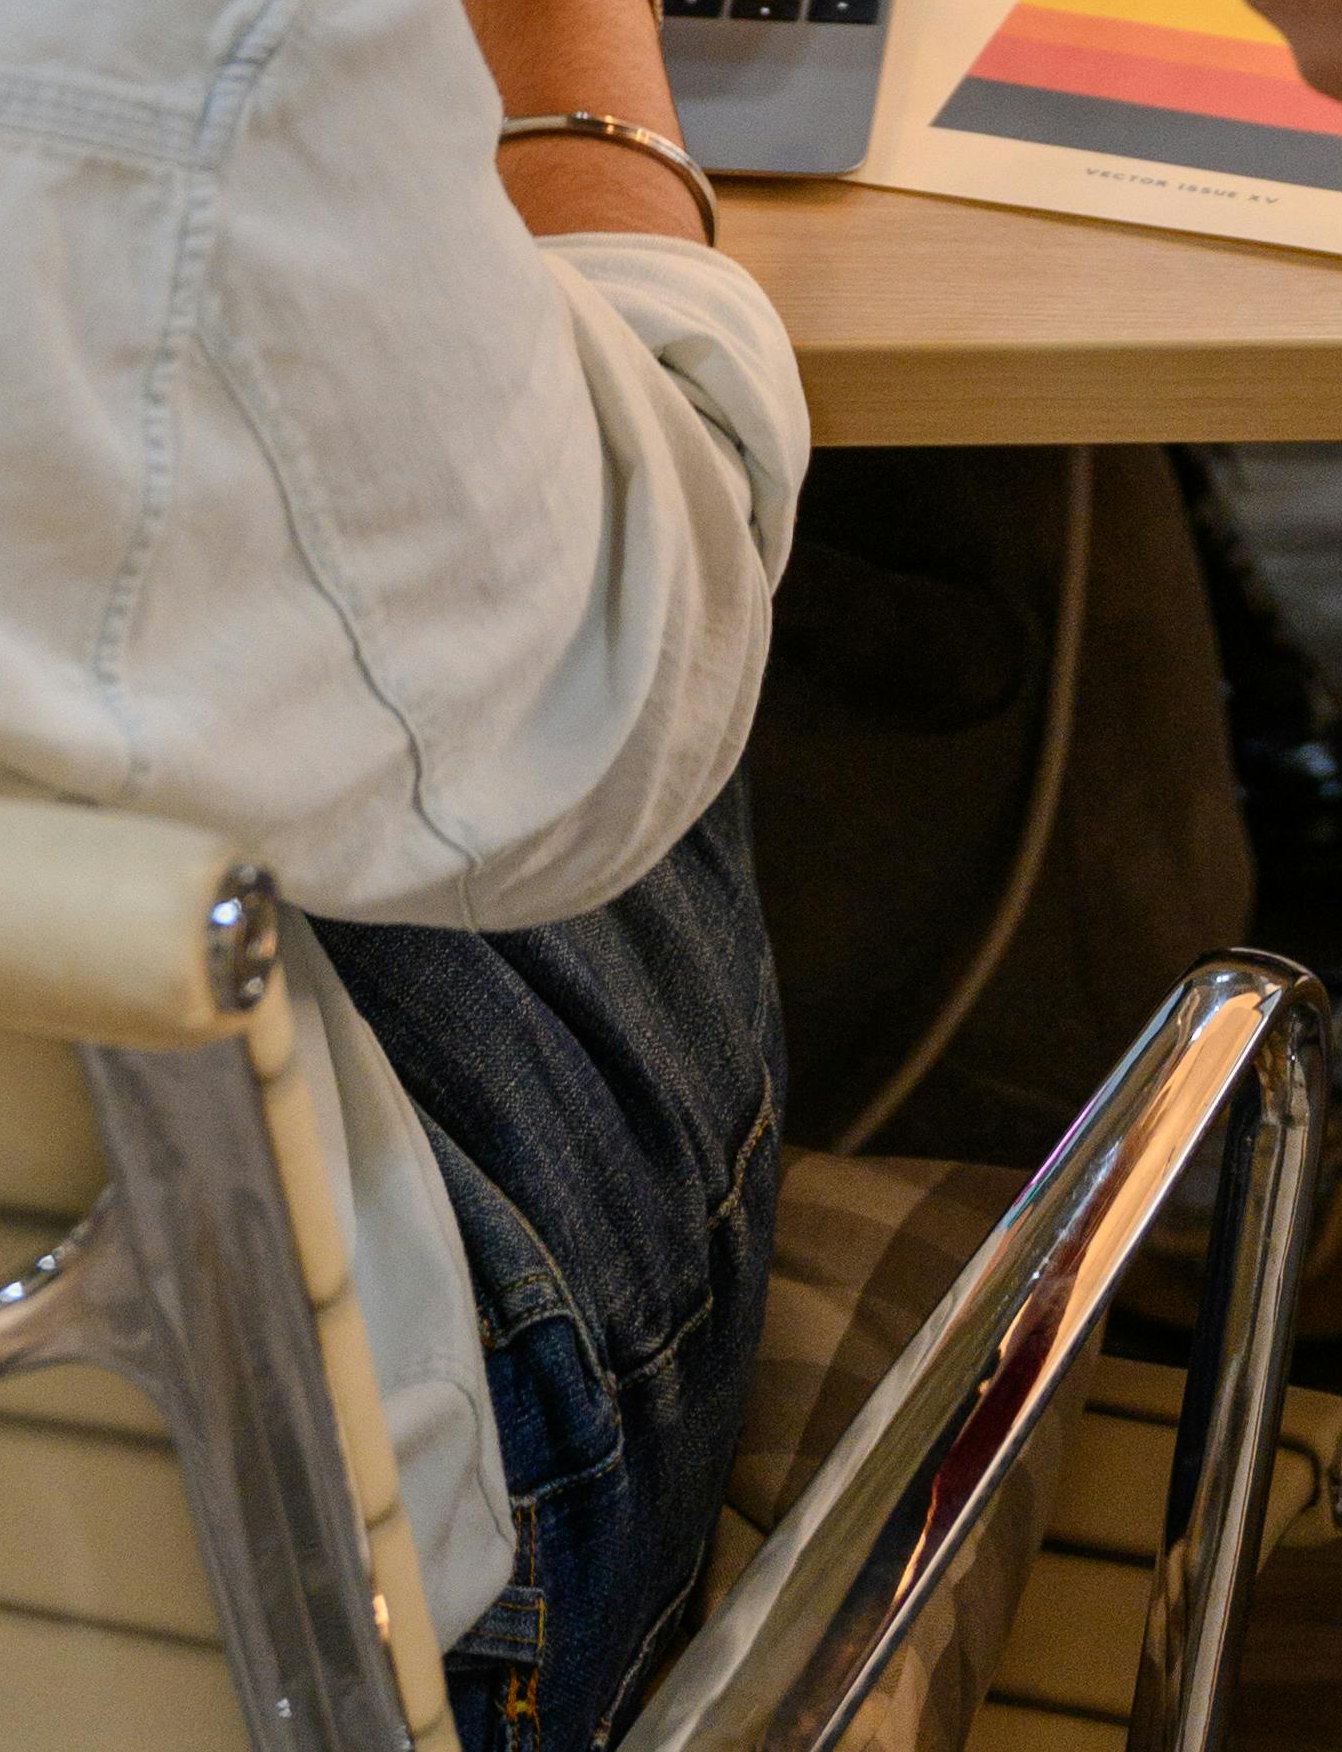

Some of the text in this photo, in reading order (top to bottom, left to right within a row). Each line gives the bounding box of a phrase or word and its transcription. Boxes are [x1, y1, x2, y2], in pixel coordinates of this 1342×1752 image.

[1086, 168, 1280, 204] VECTOR ISSUE XV
